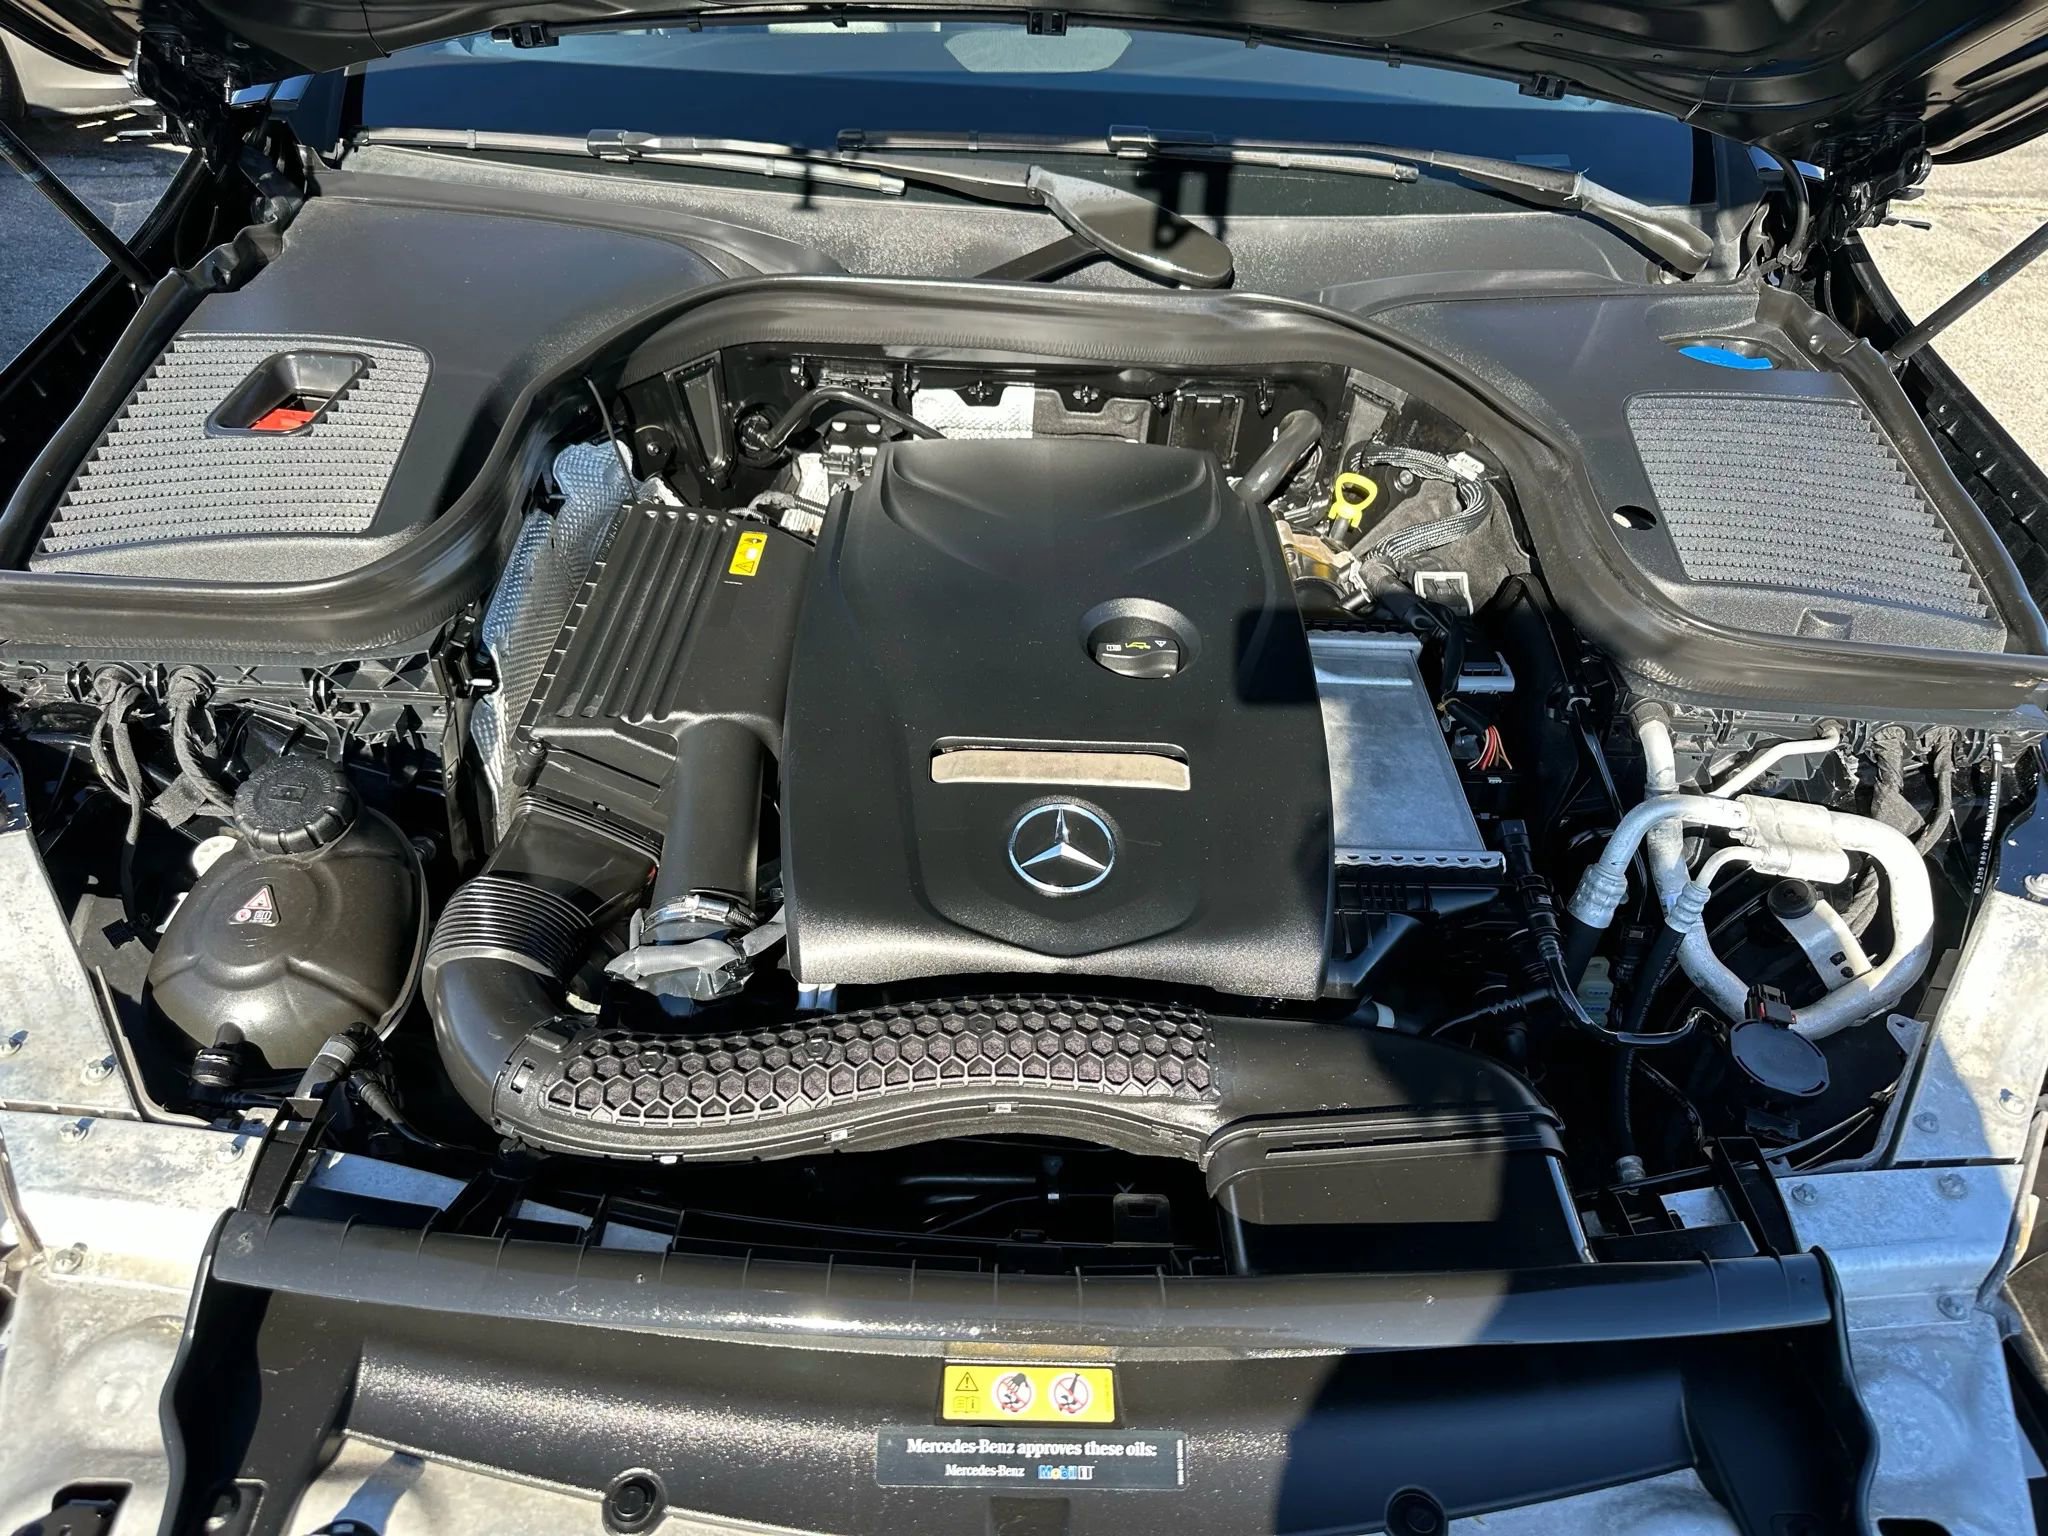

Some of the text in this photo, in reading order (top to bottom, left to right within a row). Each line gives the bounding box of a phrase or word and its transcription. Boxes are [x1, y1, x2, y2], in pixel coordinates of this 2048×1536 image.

[906, 1438, 1158, 1458] Mercedes-Benz approves these oils:
[944, 1464, 1025, 1477] Mercedes-Benz
[1038, 1464, 1078, 1480] Mobil
